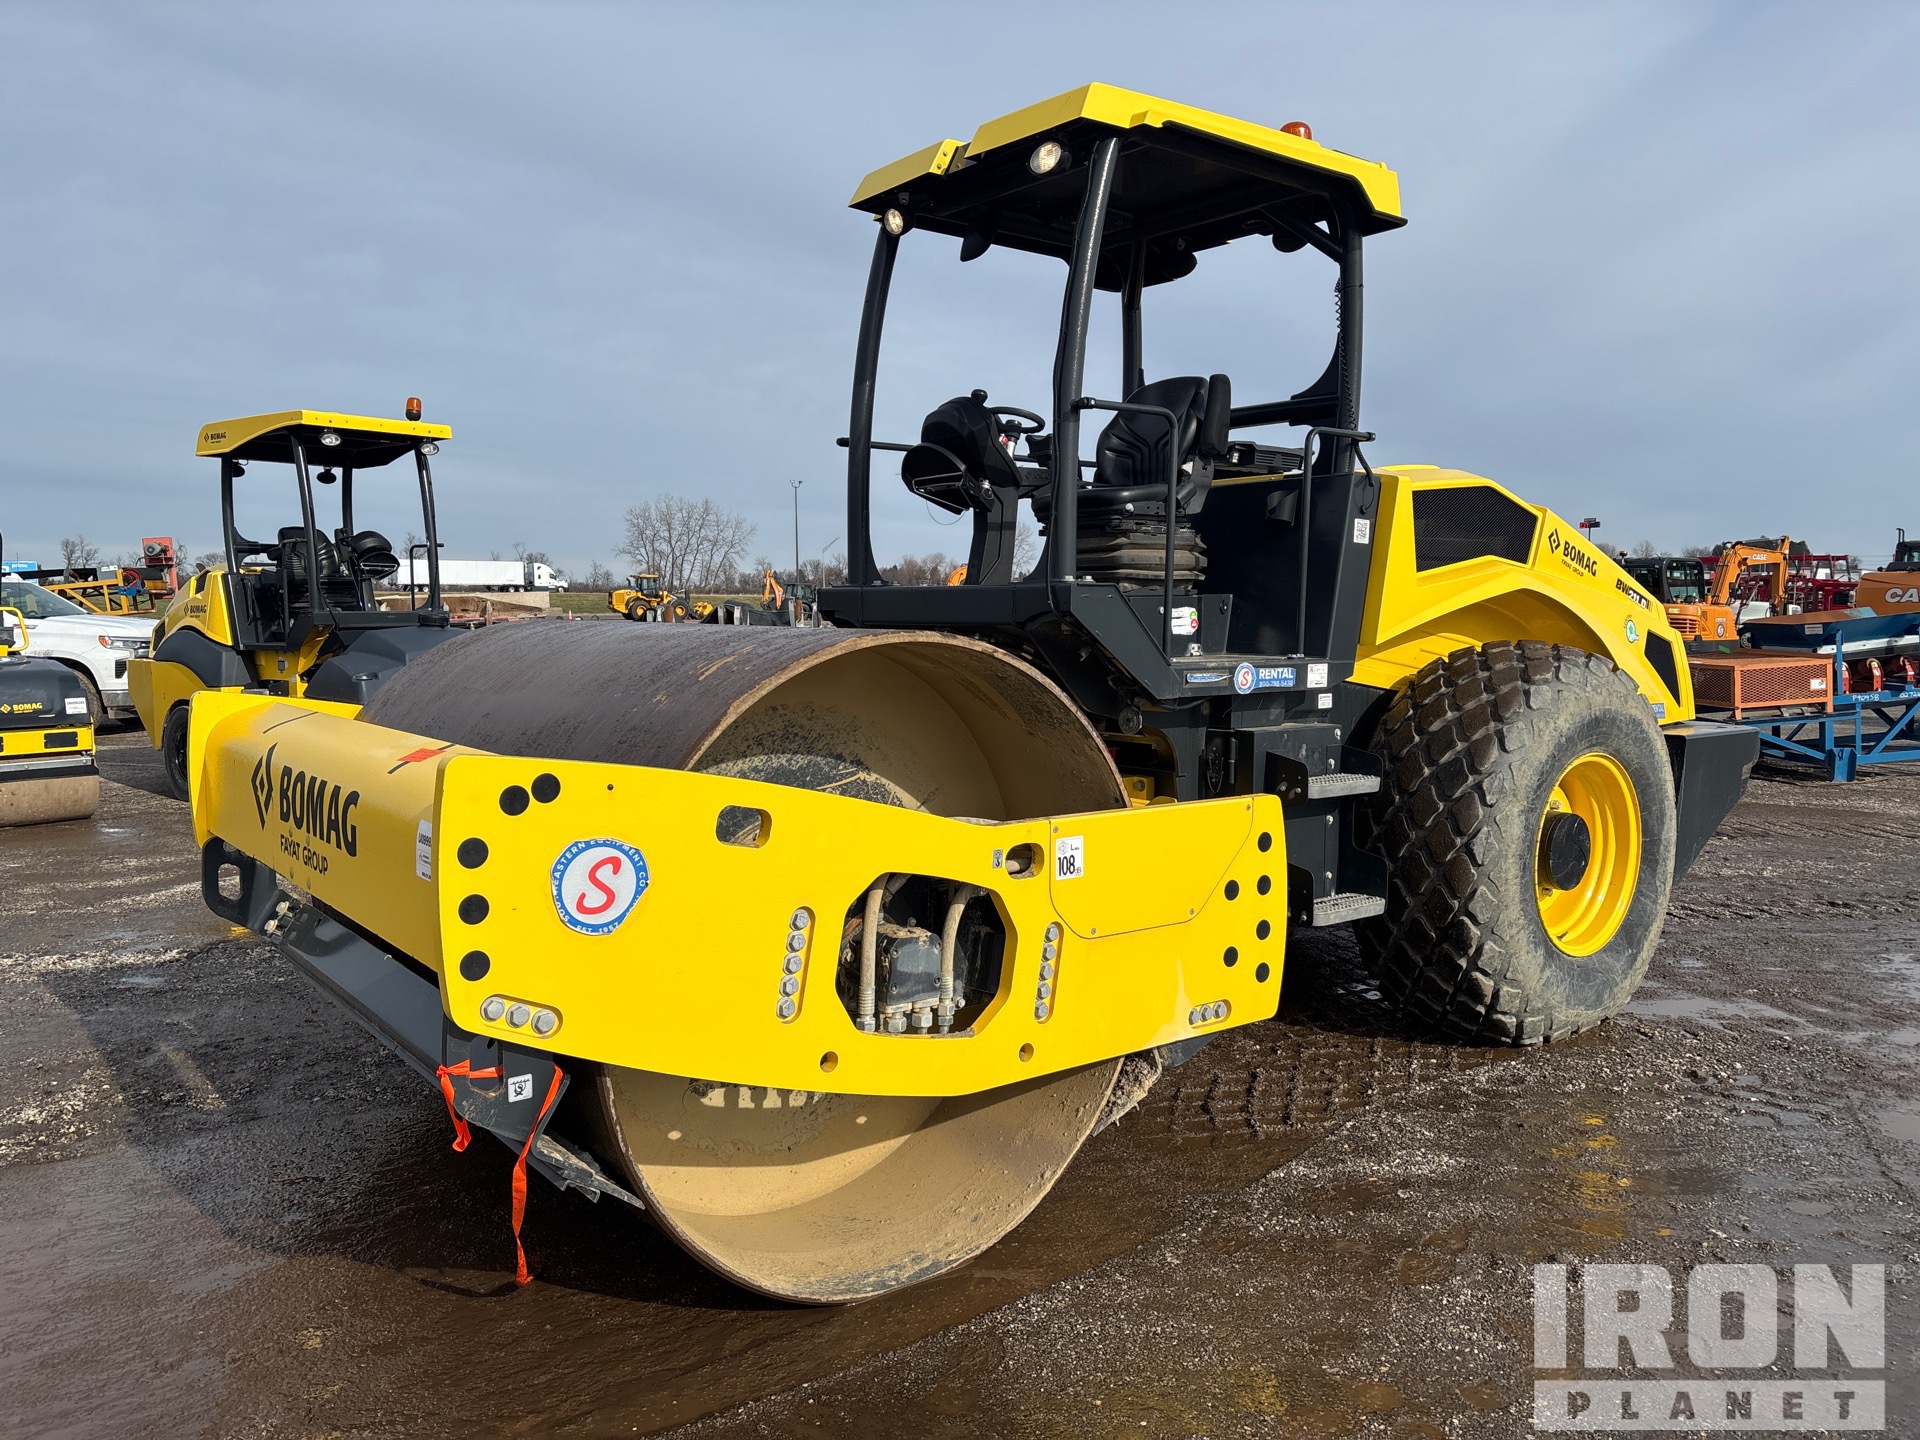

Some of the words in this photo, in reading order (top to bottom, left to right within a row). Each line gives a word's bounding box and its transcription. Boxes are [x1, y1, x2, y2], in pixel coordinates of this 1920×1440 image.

[1563, 540, 1598, 577] BOMAG
[1885, 588, 1920, 603] CA
[1259, 668, 1294, 680] RENTAL
[13, 702, 43, 711] BOMAG
[279, 765, 361, 857] BOMAG
[280, 834, 300, 861] FAYAT
[302, 846, 329, 876] GROUP
[1058, 854, 1075, 876] 108
[576, 856, 622, 915] S
[598, 921, 619, 934] 1957
